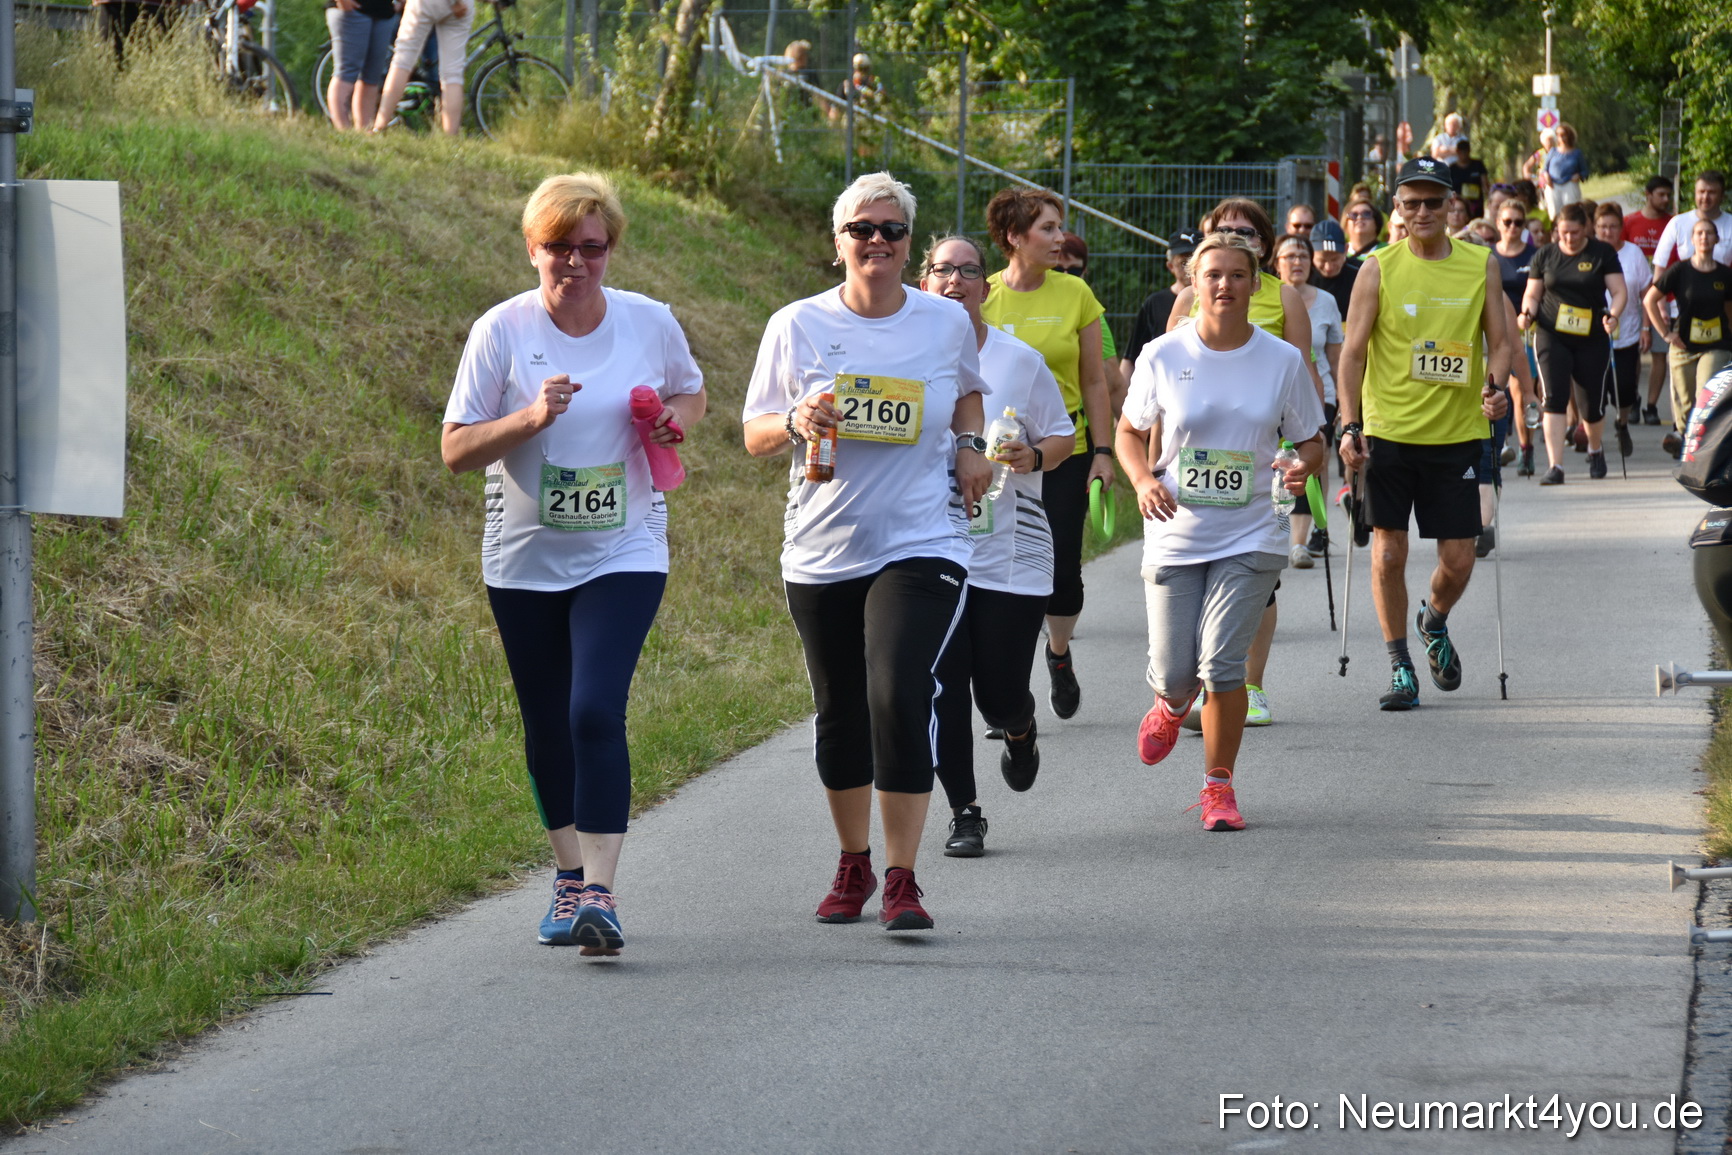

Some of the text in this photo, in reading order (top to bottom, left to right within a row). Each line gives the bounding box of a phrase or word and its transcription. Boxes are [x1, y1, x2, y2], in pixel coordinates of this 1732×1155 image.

[1568, 316, 1579, 326] 61
[1418, 354, 1464, 374] 1192
[843, 397, 911, 425] 2160
[845, 421, 887, 431] Angermayer
[1186, 468, 1243, 491] 2169
[549, 487, 617, 513] 2164
[548, 511, 618, 520] Grashaußer Gabriele
[940, 573, 959, 587] adidas
